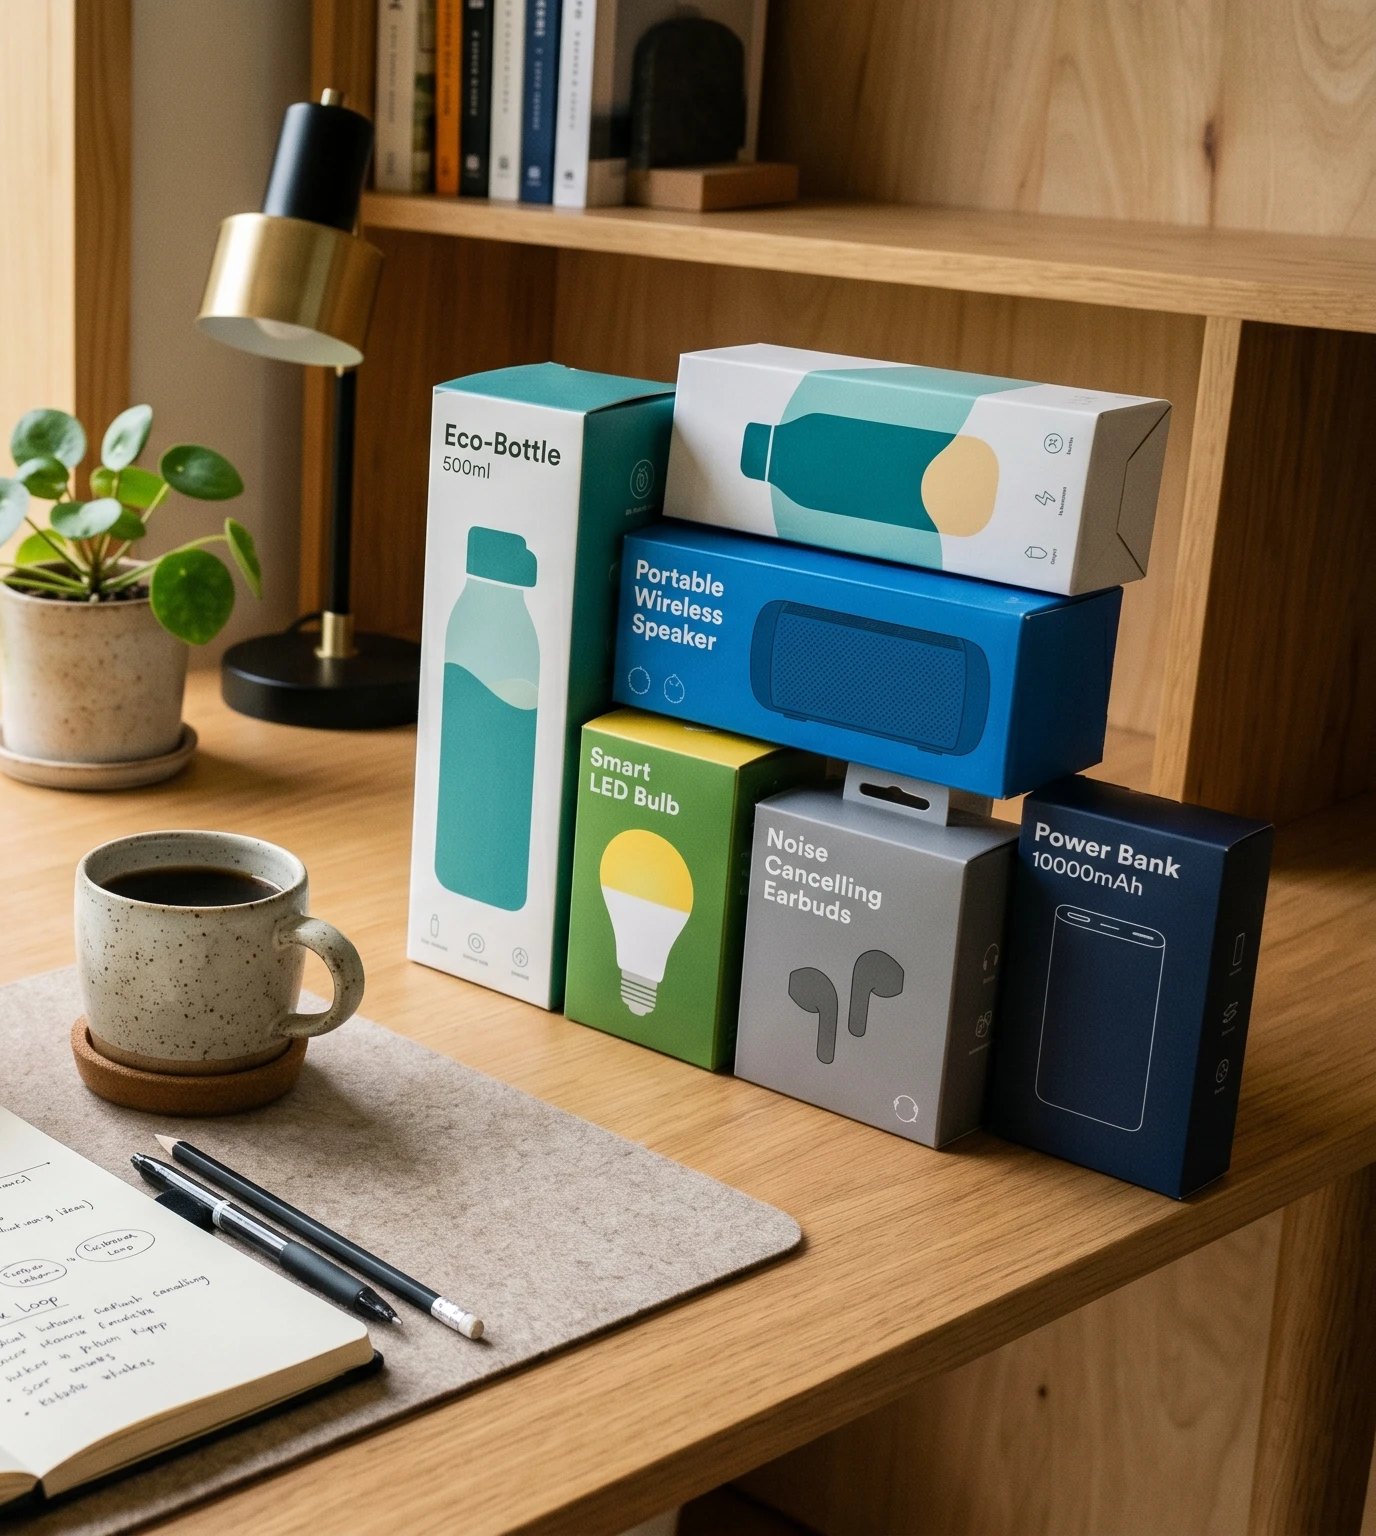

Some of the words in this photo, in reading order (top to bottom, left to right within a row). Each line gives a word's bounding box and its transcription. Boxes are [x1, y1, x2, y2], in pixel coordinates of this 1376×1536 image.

[444, 422, 561, 466] Eco-Bottle
[442, 456, 490, 479] 500ml
[636, 559, 724, 597] Portable
[634, 585, 723, 625] Wireless
[632, 613, 717, 651] Speaker
[590, 746, 651, 782] Smart
[590, 772, 629, 801] LED
[634, 785, 680, 816] Bulb
[767, 827, 828, 863] Noise
[1034, 821, 1111, 859] Power
[1117, 843, 1182, 879] Bank
[765, 855, 882, 910] Cancelling
[1032, 851, 1143, 896] 10000mAh
[763, 880, 851, 924] Earbuds
[14, 1296, 58, 1312] Loop
